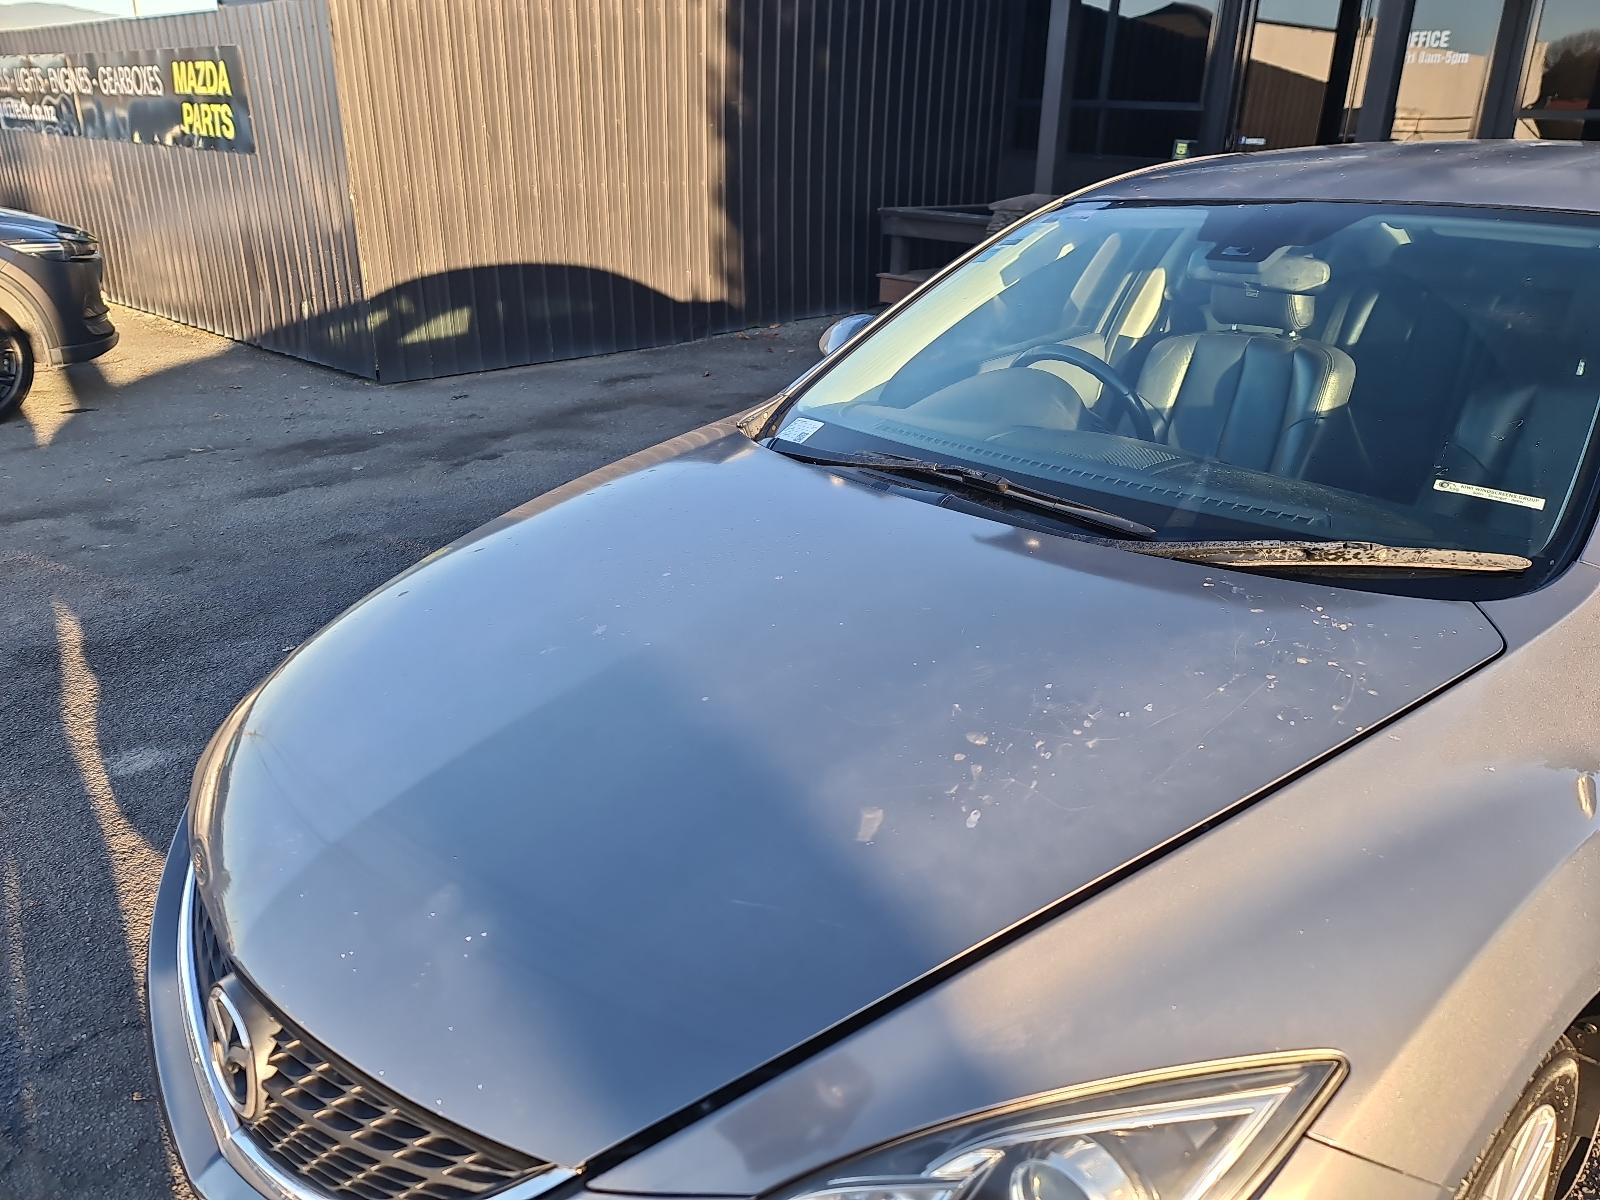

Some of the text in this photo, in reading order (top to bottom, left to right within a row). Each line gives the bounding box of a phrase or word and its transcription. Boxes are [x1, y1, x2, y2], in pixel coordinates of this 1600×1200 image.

[47, 66, 93, 95] ENGINES
[98, 65, 164, 96] GEARBOXES
[171, 60, 232, 96] MAZDA
[181, 102, 235, 140] PARTS
